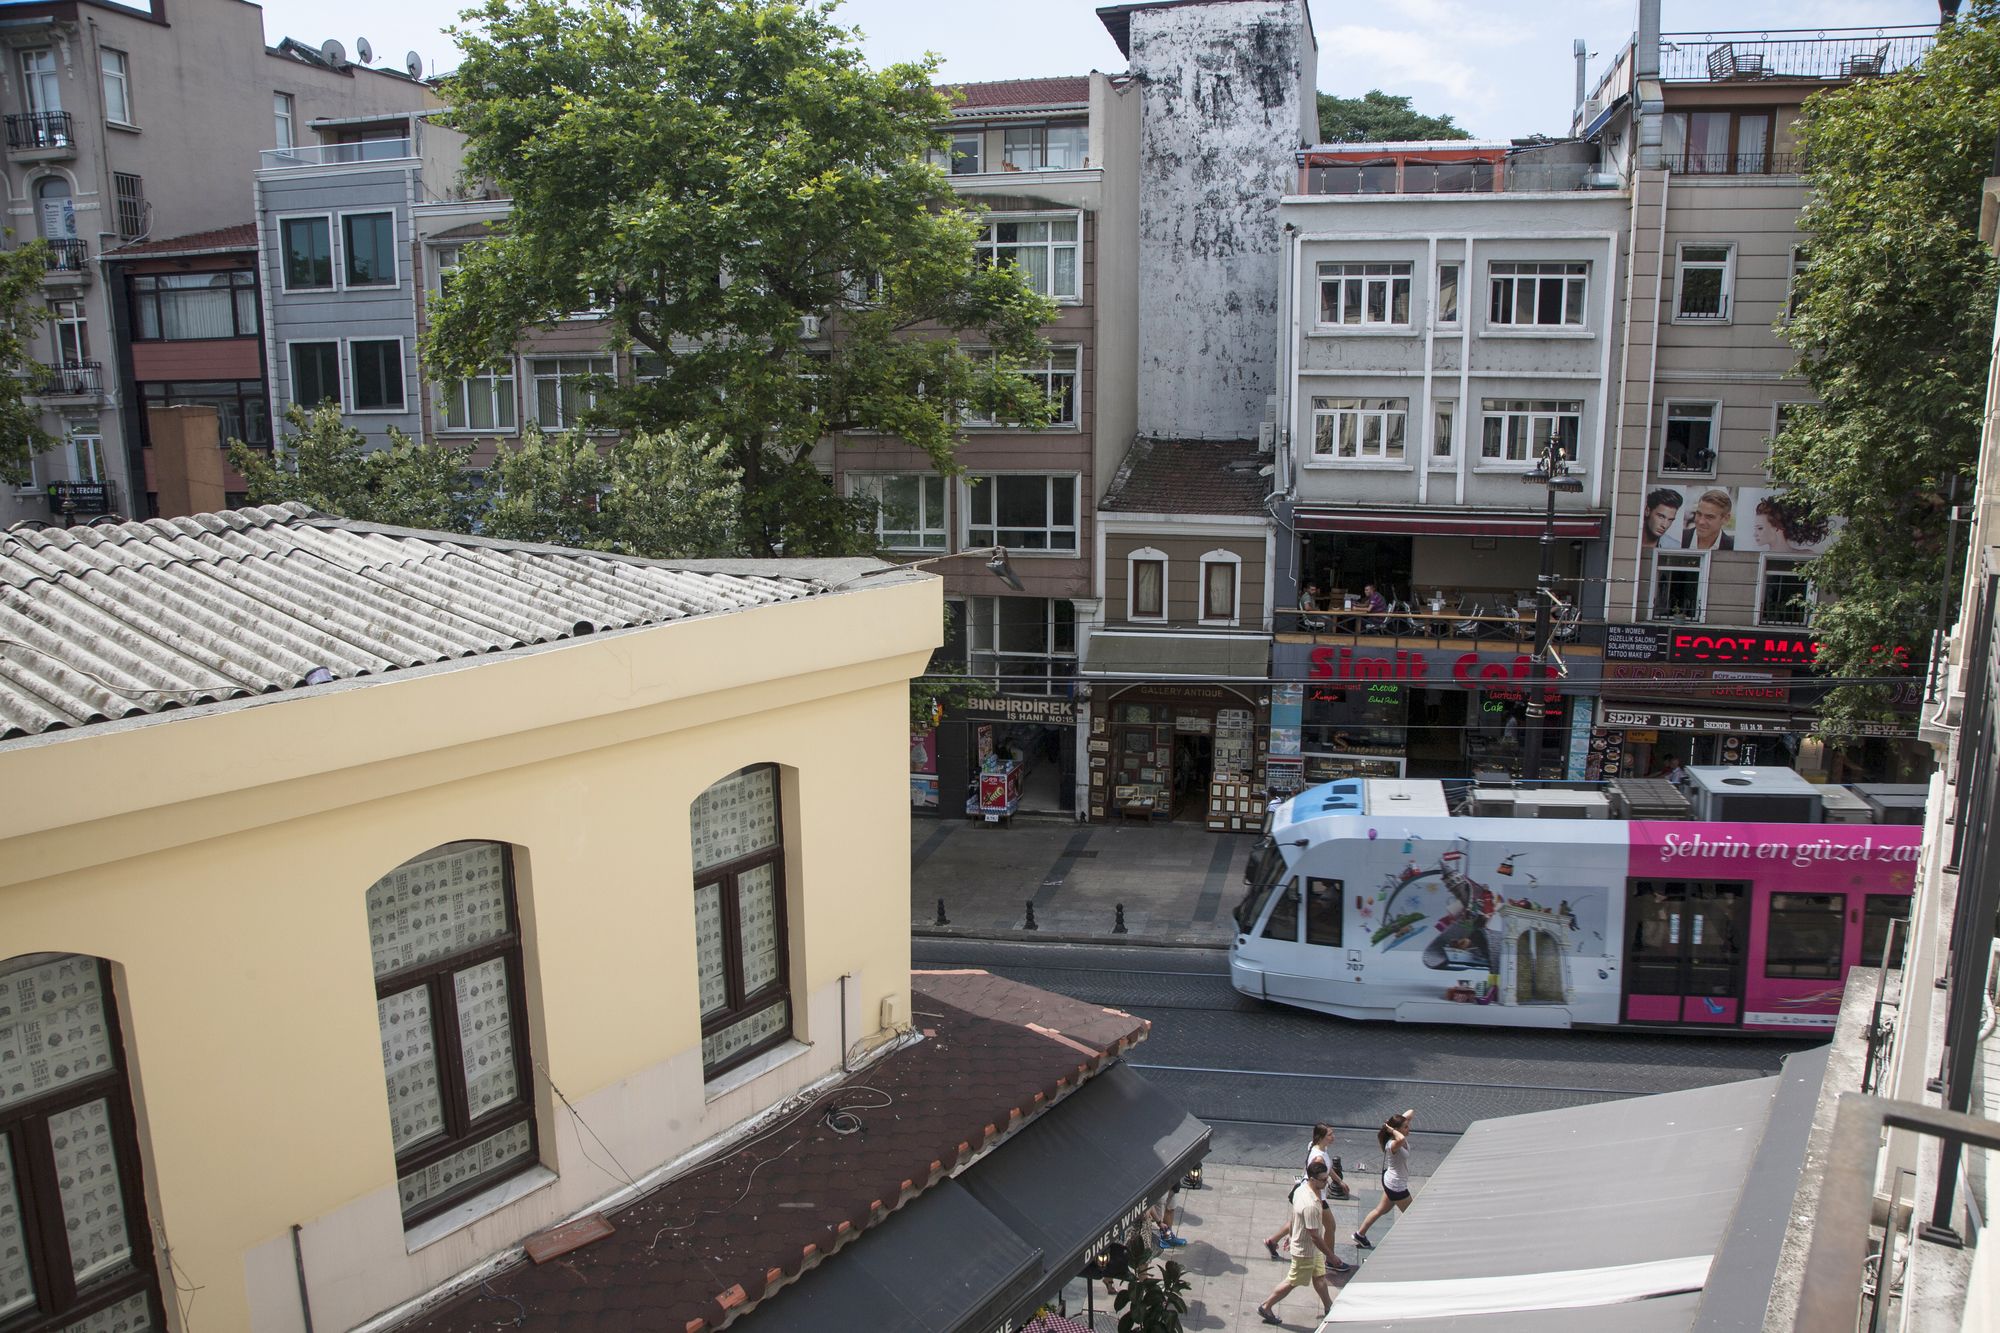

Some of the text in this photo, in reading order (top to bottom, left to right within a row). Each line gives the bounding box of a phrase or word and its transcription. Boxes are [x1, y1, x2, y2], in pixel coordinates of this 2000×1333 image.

[1609, 626, 1621, 634] MEN
[1607, 642, 1635, 650] SOLARYUM
[1635, 636, 1656, 644] SALONU
[1675, 635, 1757, 661] FOOT
[1607, 650, 1652, 660] TATTOO MAKE UP
[1308, 646, 1430, 687] Simit
[1140, 687, 1224, 698] GALLERY ANTIQUE
[1019, 713, 1043, 721] HANI
[1608, 712, 1651, 725] SEDEF
[1660, 833, 1752, 863] Şehrin
[1755, 843, 1790, 859] en
[1791, 837, 1874, 868] güzel
[24, 1020, 41, 1034] LIFE
[1084, 1196, 1148, 1265] DINE & WINE
